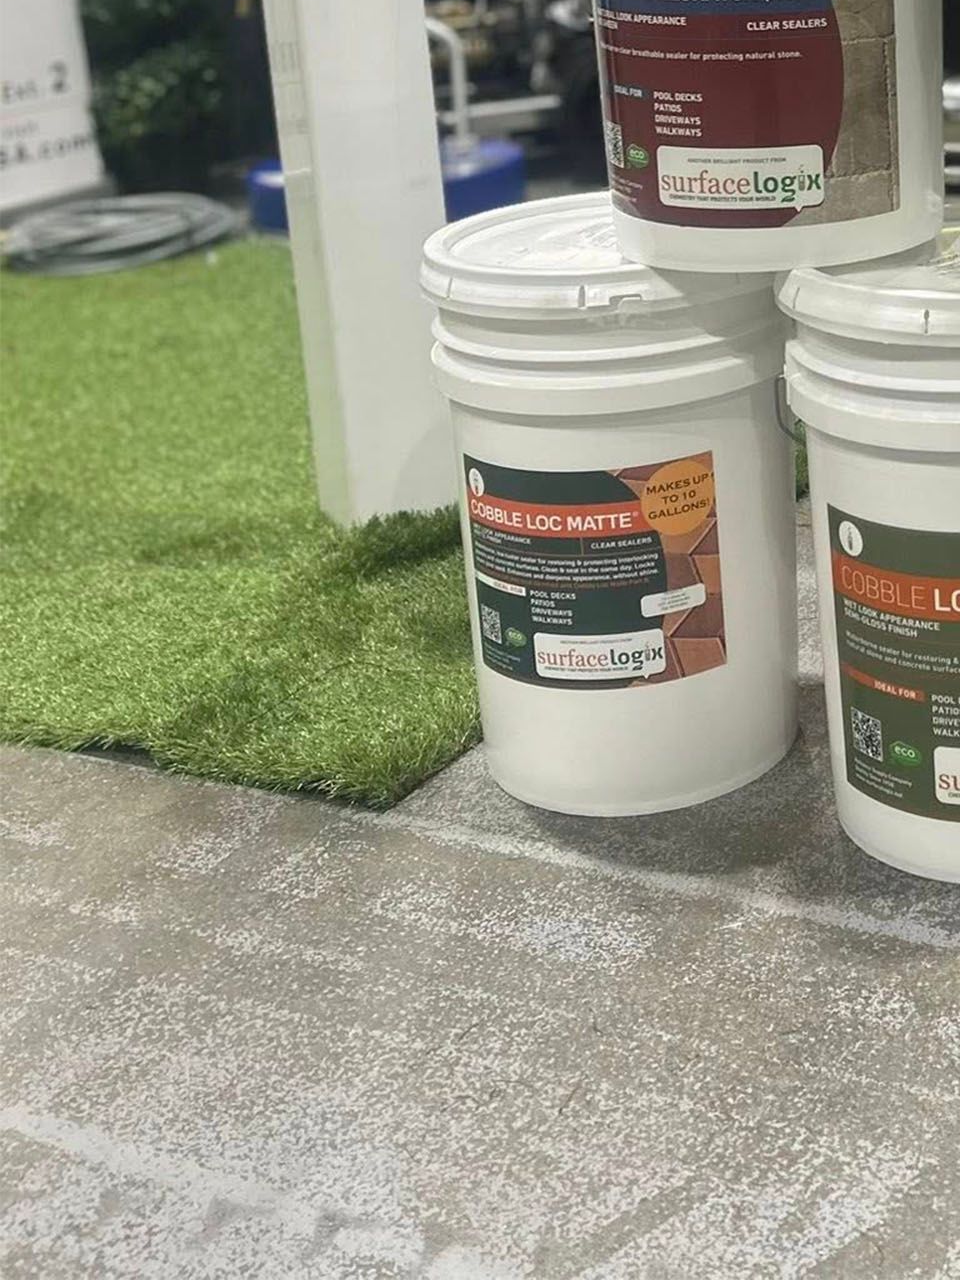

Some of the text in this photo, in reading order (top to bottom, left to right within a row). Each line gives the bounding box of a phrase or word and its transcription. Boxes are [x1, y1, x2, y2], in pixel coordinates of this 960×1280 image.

[634, 14, 828, 31] APPEARANCE CLEAR SEALERS
[702, 51, 743, 62] protecting
[745, 51, 776, 59] natural
[653, 91, 703, 102] POOL DECKS
[654, 103, 682, 113] PATIOS
[655, 114, 702, 125] DRIVEWAYS
[655, 126, 702, 137] WALKWAYS
[661, 164, 822, 202] surfacelogix
[646, 473, 709, 495] MAKES UP
[661, 490, 696, 504] TO 10
[471, 499, 633, 532] COBBLE LOC MATTE
[590, 537, 652, 549] CLEAR SEALERS
[842, 565, 927, 610] COBBLE
[530, 590, 576, 600] POOL DECKS
[858, 605, 878, 619] LOOK
[880, 612, 941, 631] APPEARANCE
[888, 624, 918, 638] FINISH
[537, 640, 664, 671] surfacelogix
[914, 652, 951, 665] restoring
[874, 680, 897, 695] IDEAL
[899, 688, 917, 699] FOR
[931, 694, 956, 705] POOL
[894, 745, 916, 758] eco
